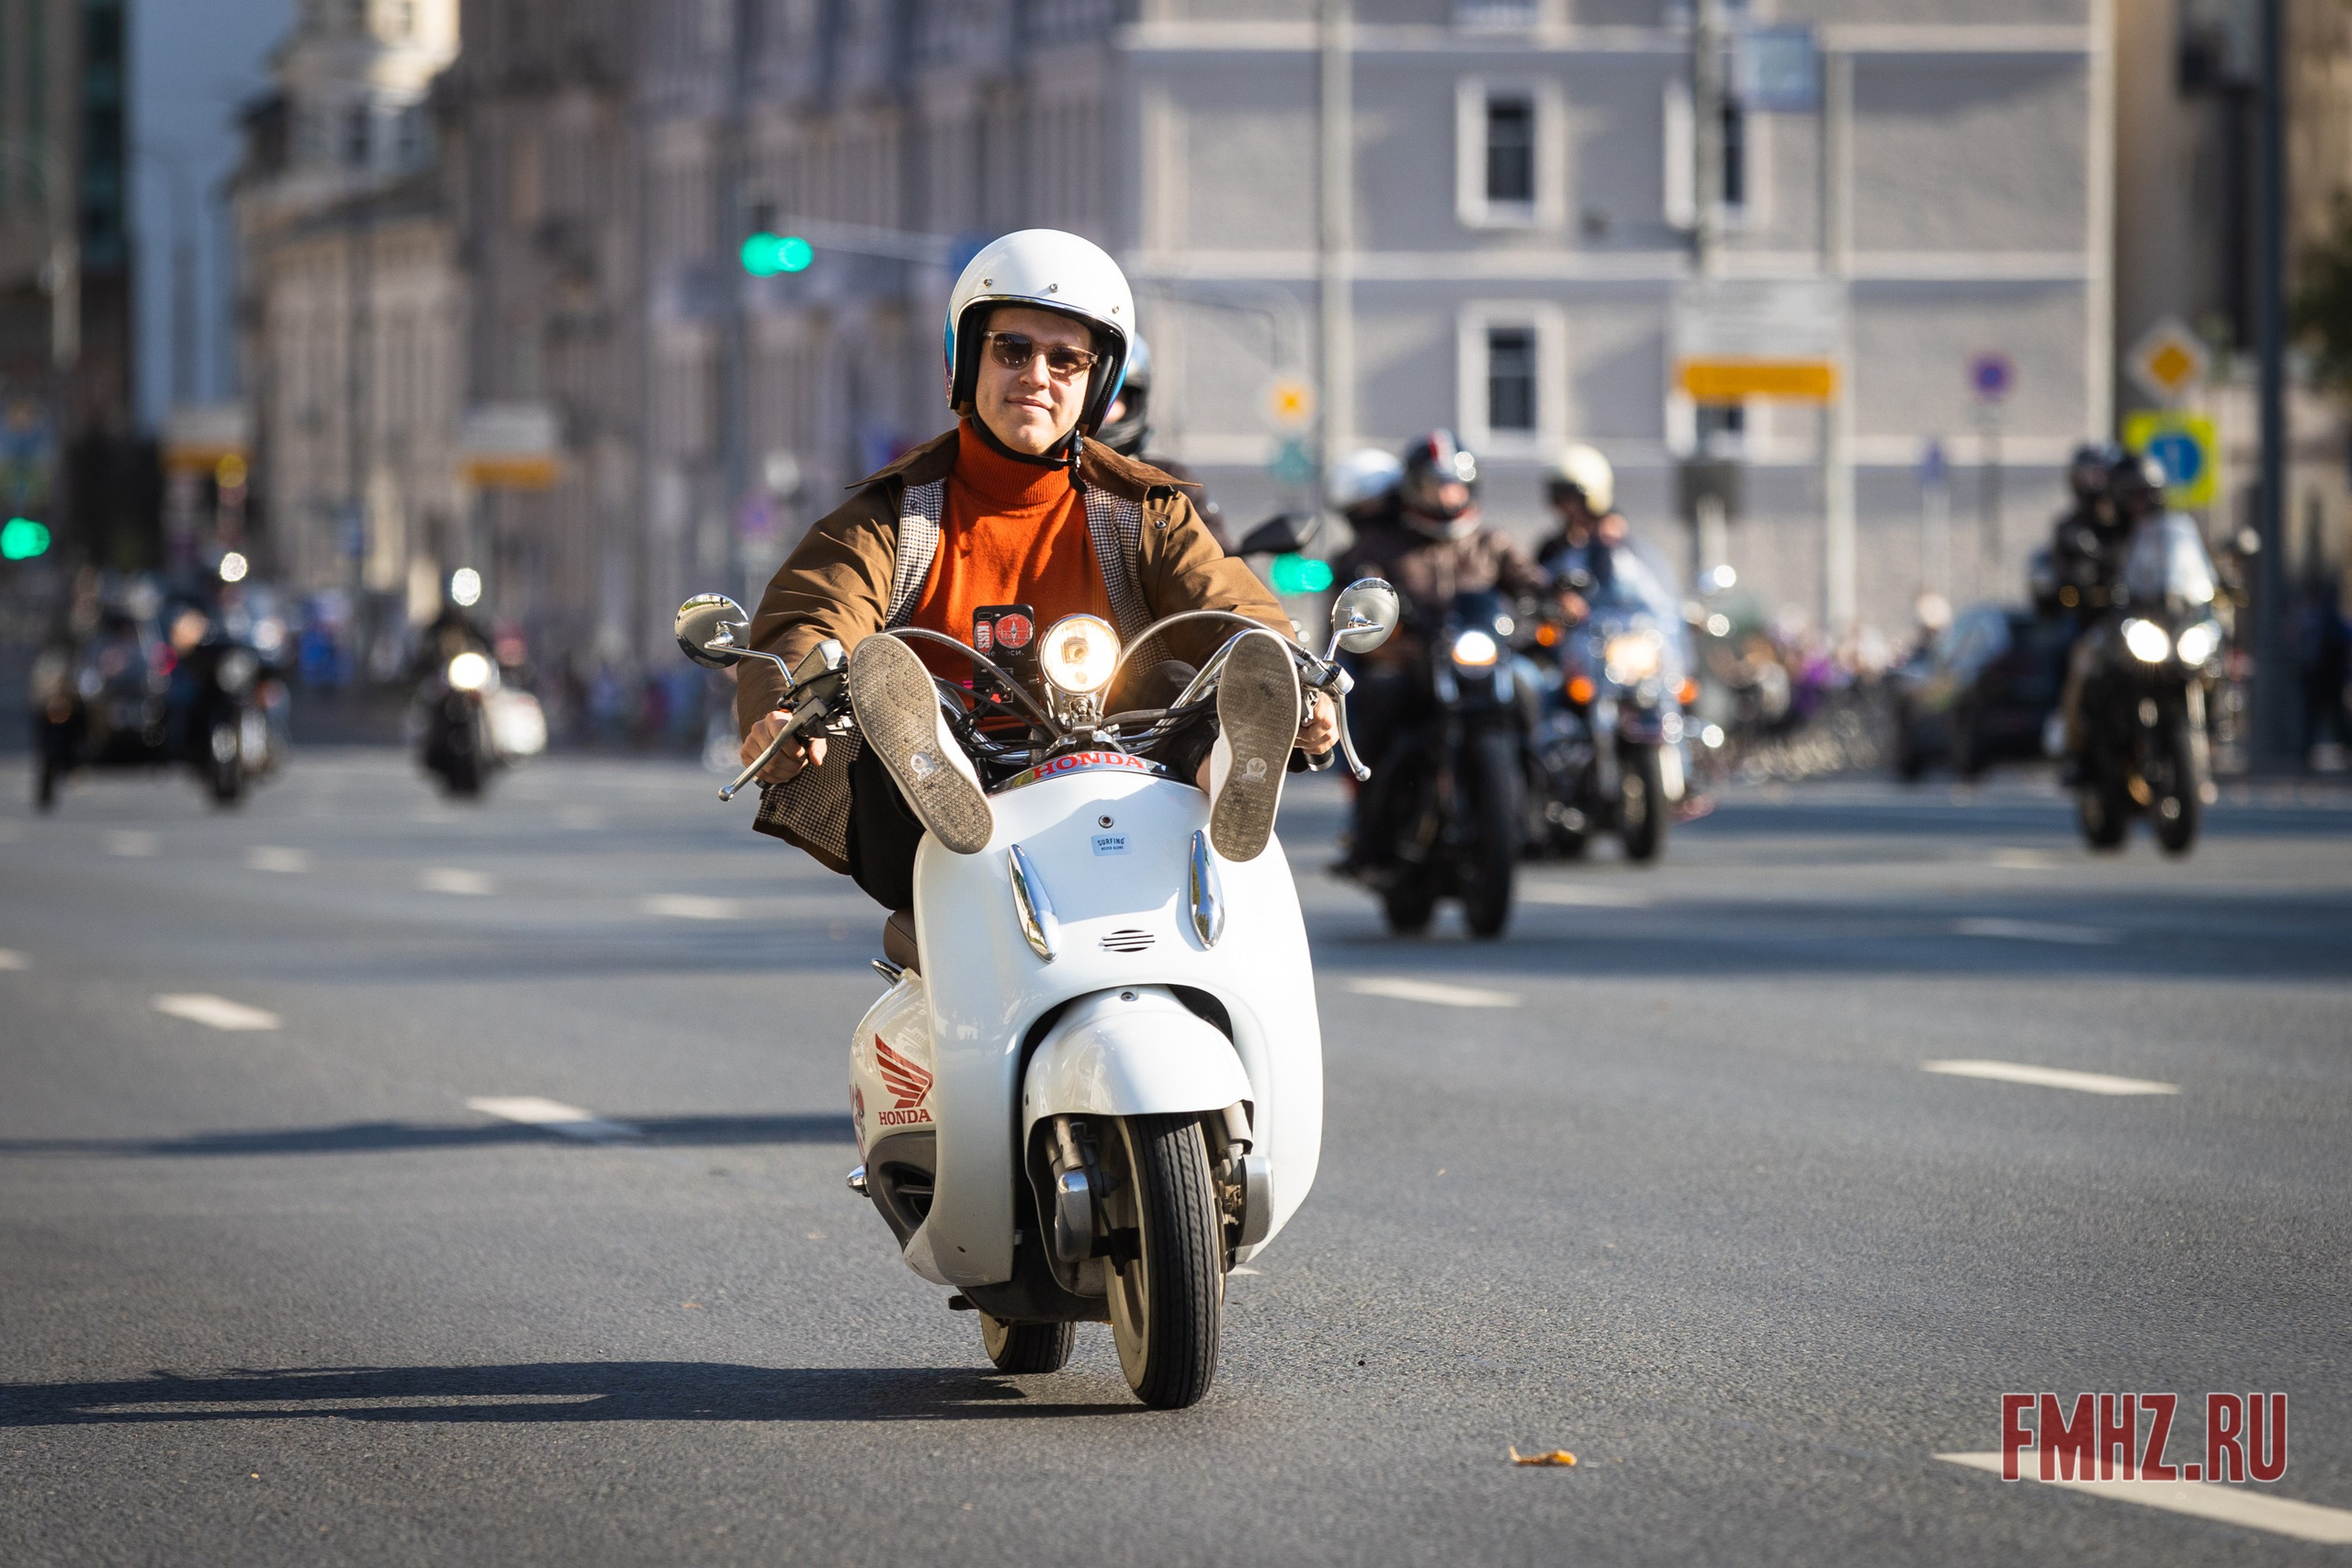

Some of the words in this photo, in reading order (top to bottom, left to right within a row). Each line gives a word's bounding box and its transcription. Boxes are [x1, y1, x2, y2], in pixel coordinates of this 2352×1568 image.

[977, 625, 989, 649] KISS
[1033, 752, 1145, 779] HONDA
[1097, 837, 1125, 846] SURFING
[878, 1109, 933, 1125] HONDA
